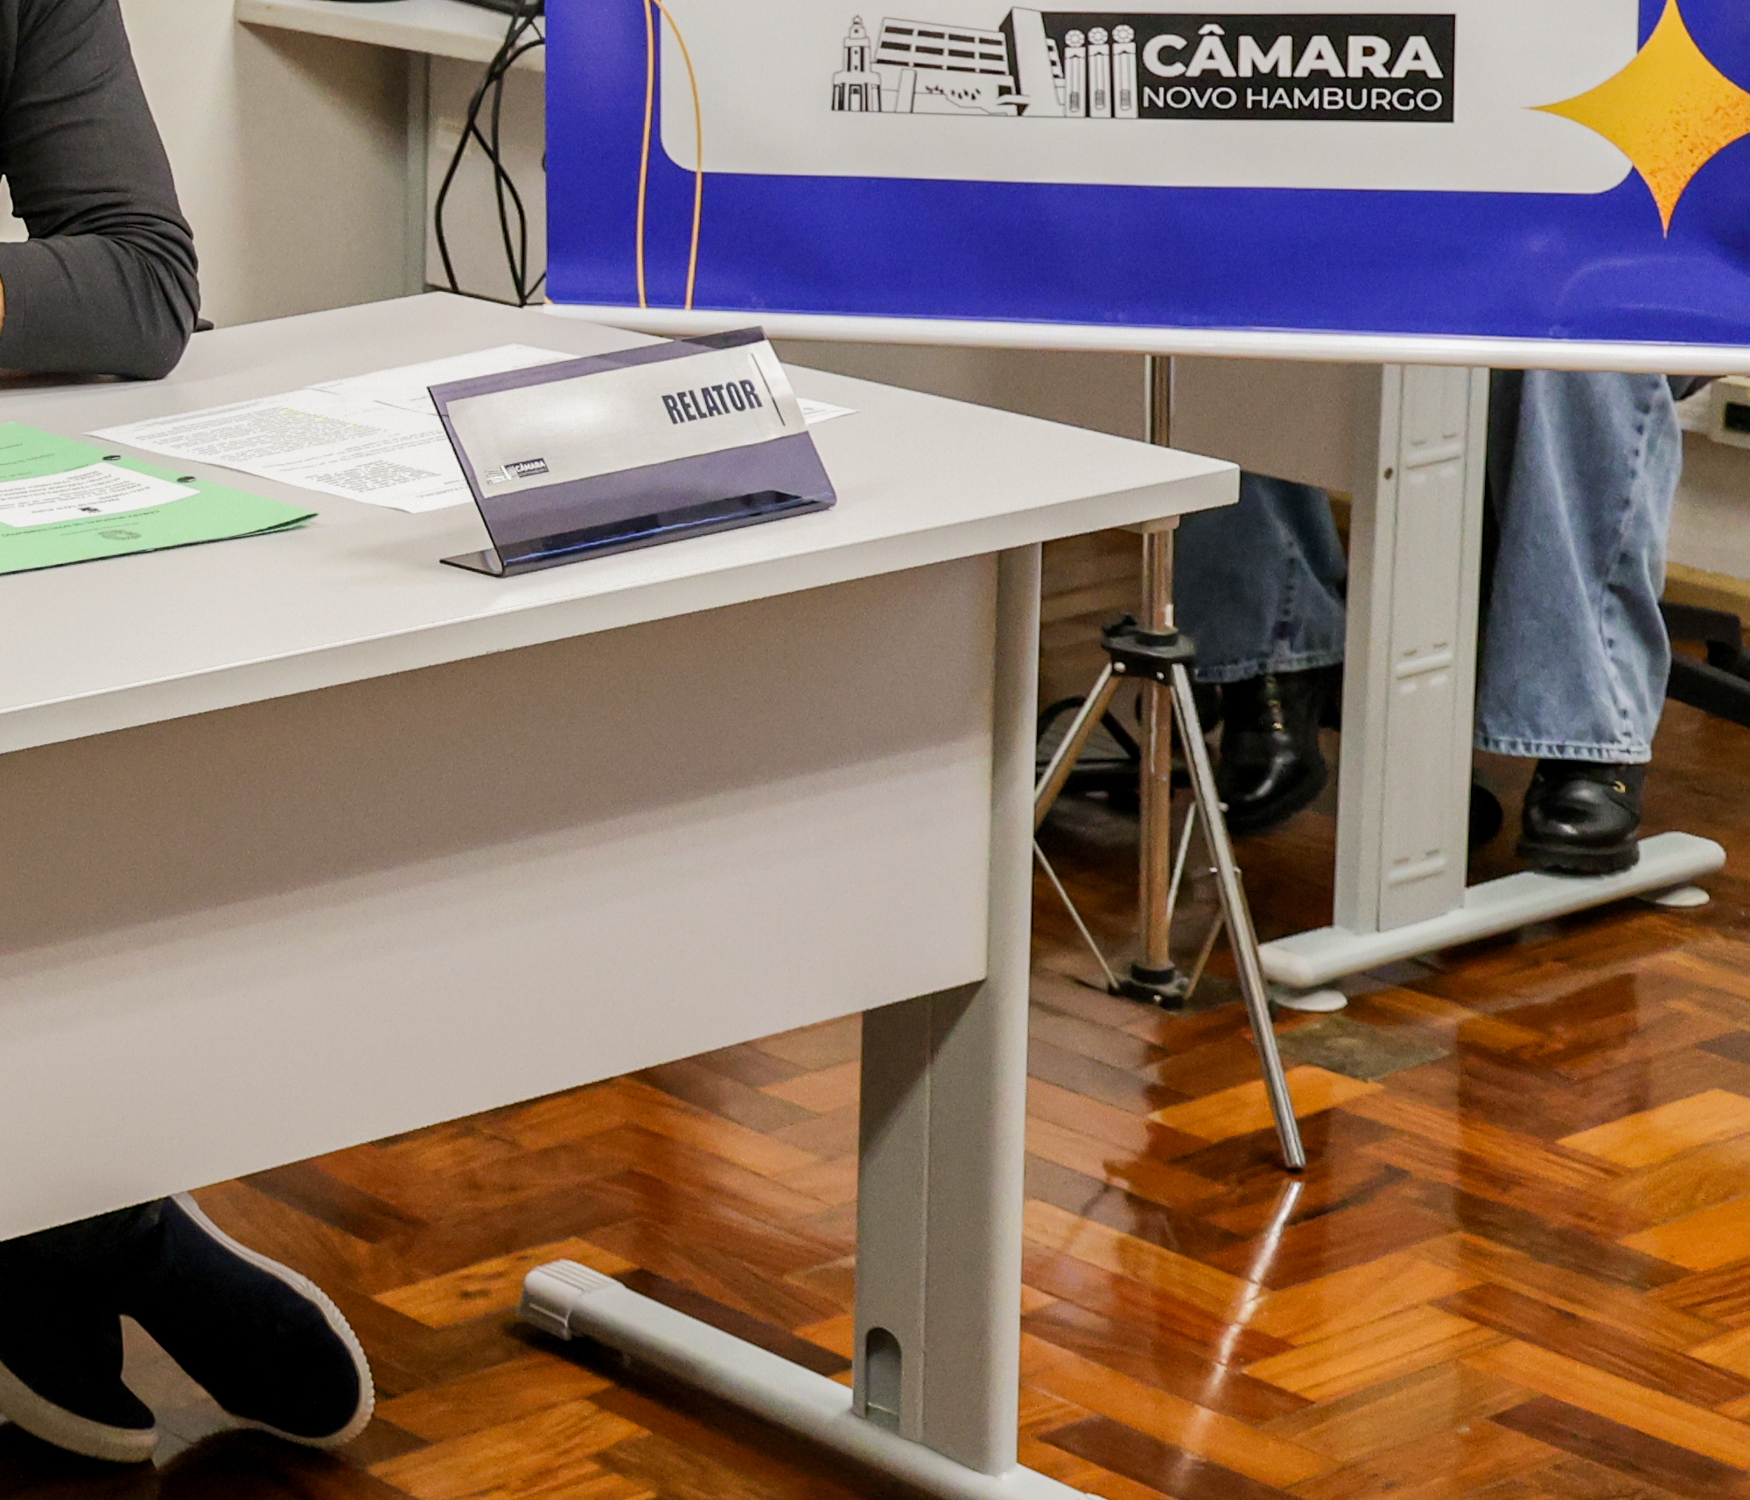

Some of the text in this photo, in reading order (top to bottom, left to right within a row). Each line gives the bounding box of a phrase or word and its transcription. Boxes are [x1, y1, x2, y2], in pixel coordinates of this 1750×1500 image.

[1142, 23, 1444, 79] CÂMARA
[1143, 86, 1443, 111] NOVO HAMBURGO
[661, 379, 763, 425] RELATOR
[515, 460, 546, 473] CÂMARA
